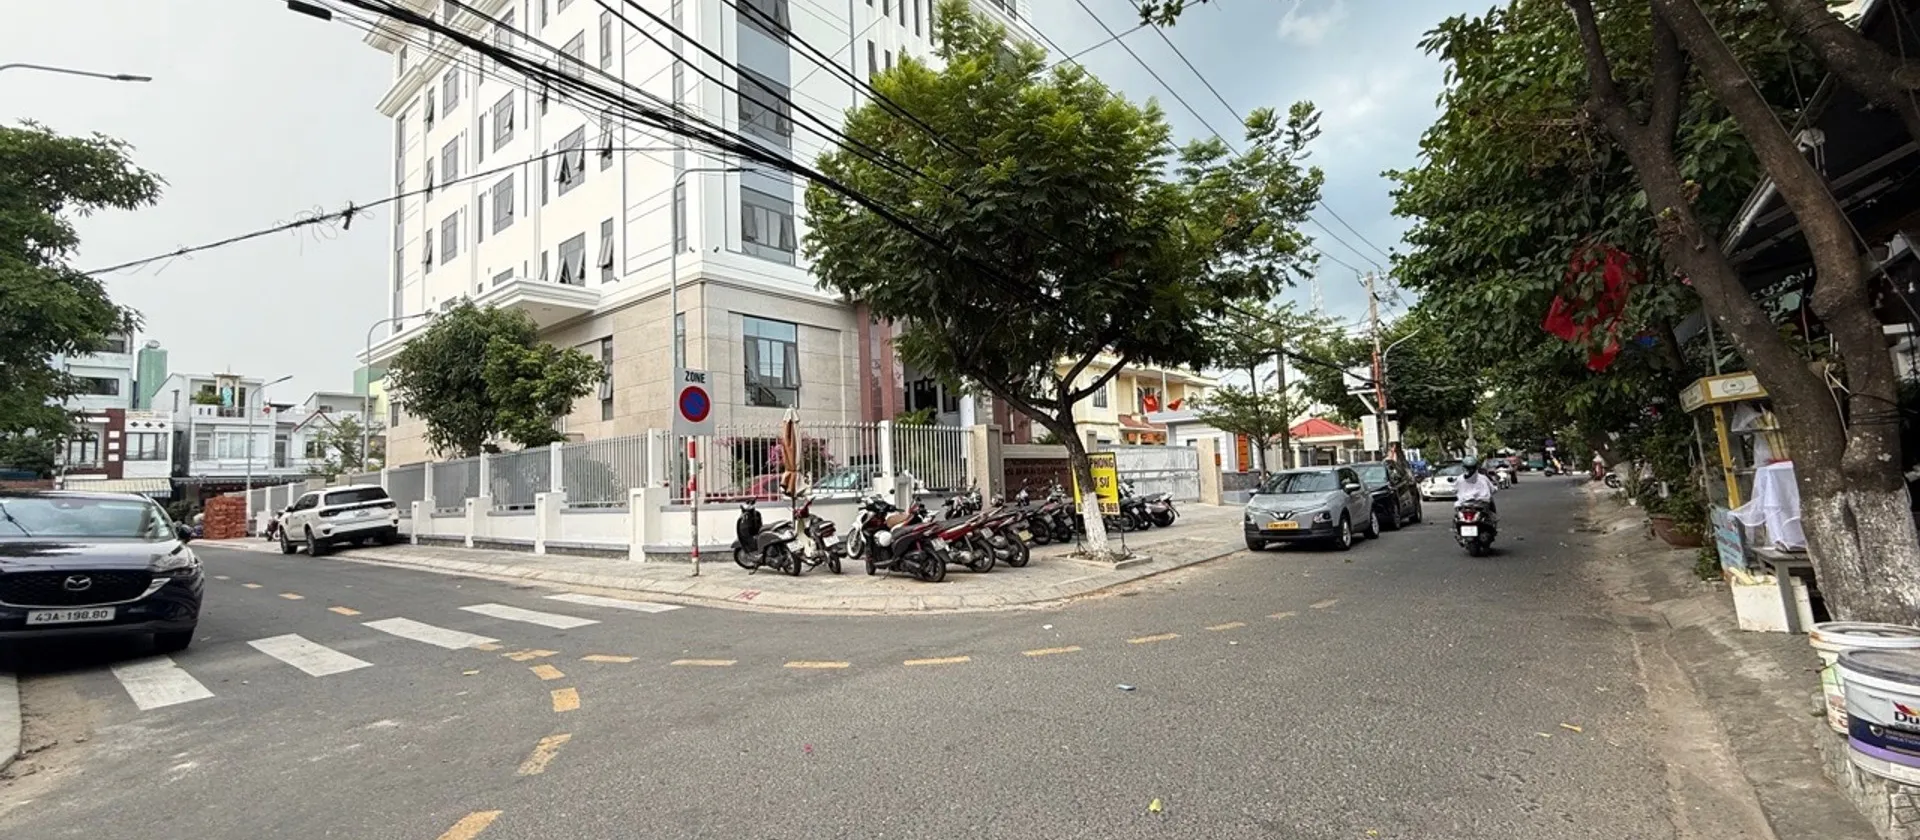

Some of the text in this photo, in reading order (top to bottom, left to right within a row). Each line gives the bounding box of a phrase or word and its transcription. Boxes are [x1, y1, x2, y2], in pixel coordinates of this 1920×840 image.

[685, 370, 706, 384] ZONE
[35, 610, 108, 621] 43A-198.80
[1894, 711, 1920, 724] Du
